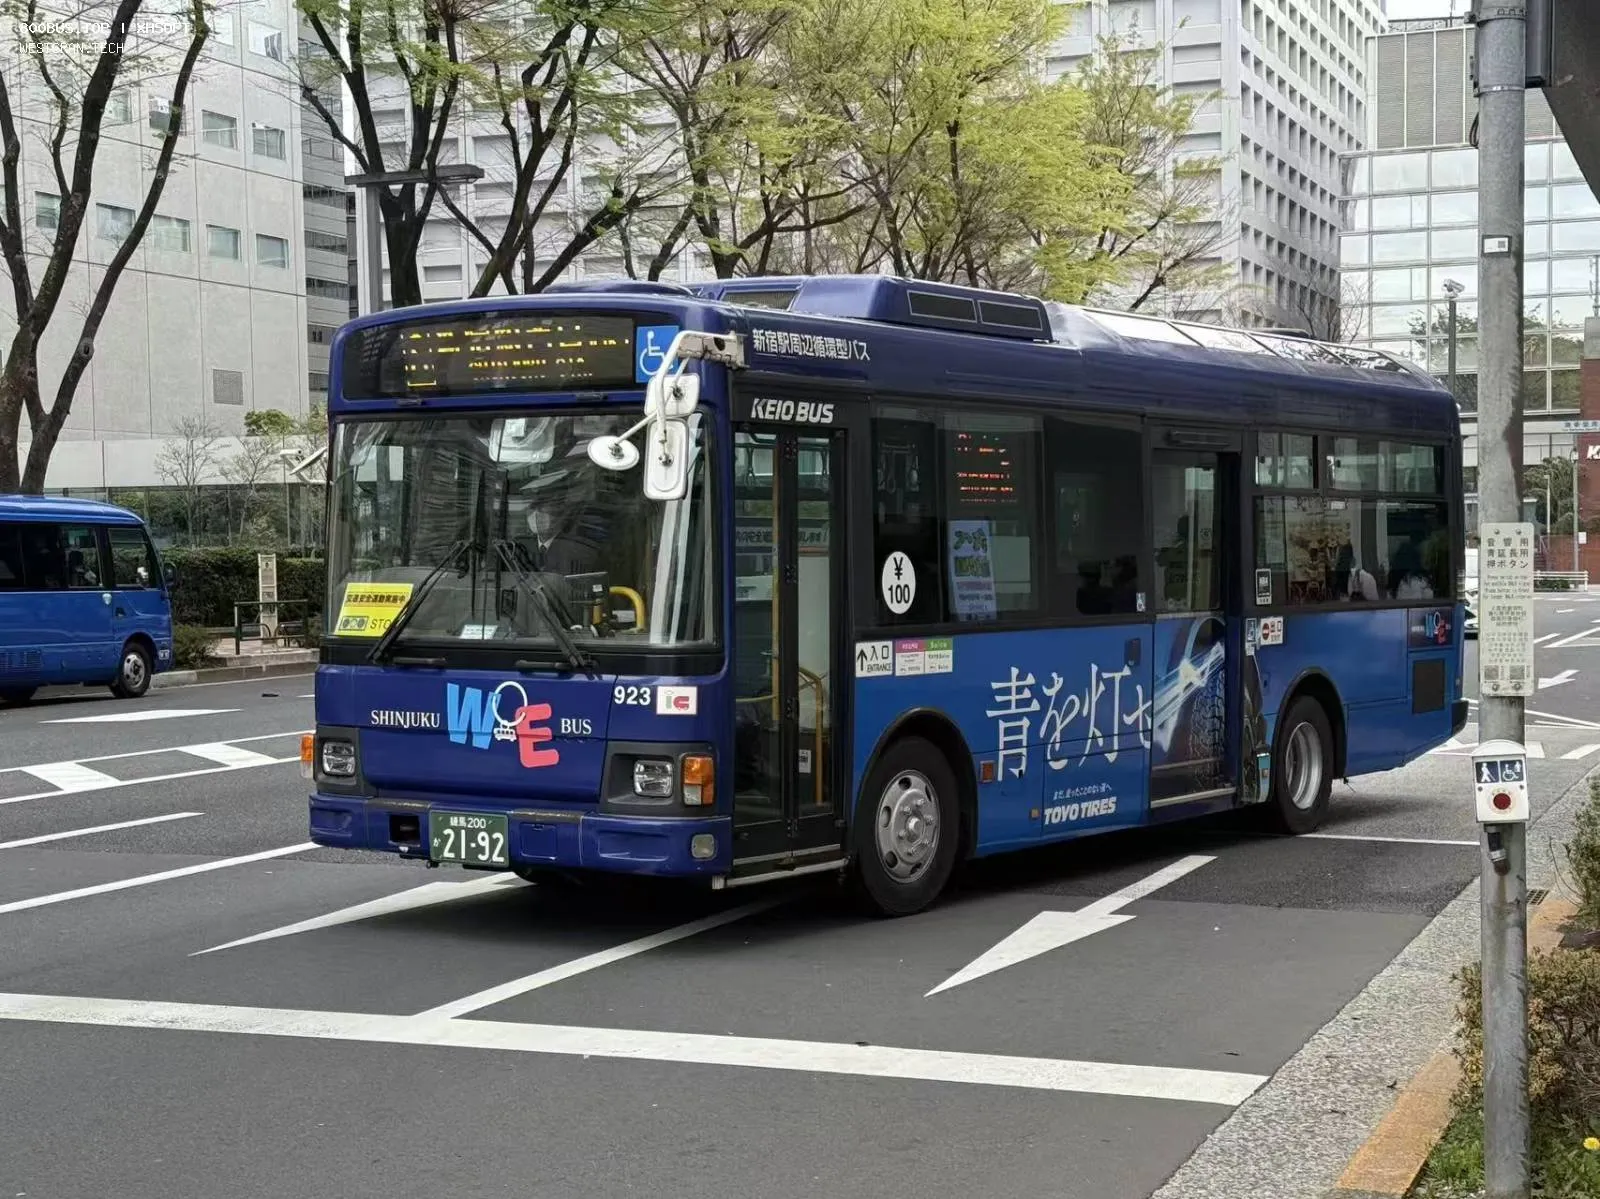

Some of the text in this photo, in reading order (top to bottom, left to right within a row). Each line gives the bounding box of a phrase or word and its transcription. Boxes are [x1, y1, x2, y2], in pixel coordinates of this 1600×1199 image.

[751, 398, 834, 424] KEIO BUS
[888, 584, 910, 604] 100
[613, 685, 651, 706] 923
[370, 709, 441, 729] SHINJUKU
[560, 717, 592, 735] BUS
[467, 817, 487, 829] 200
[1044, 797, 1117, 825] TOYO TIRES
[443, 828, 505, 863] 21-92
